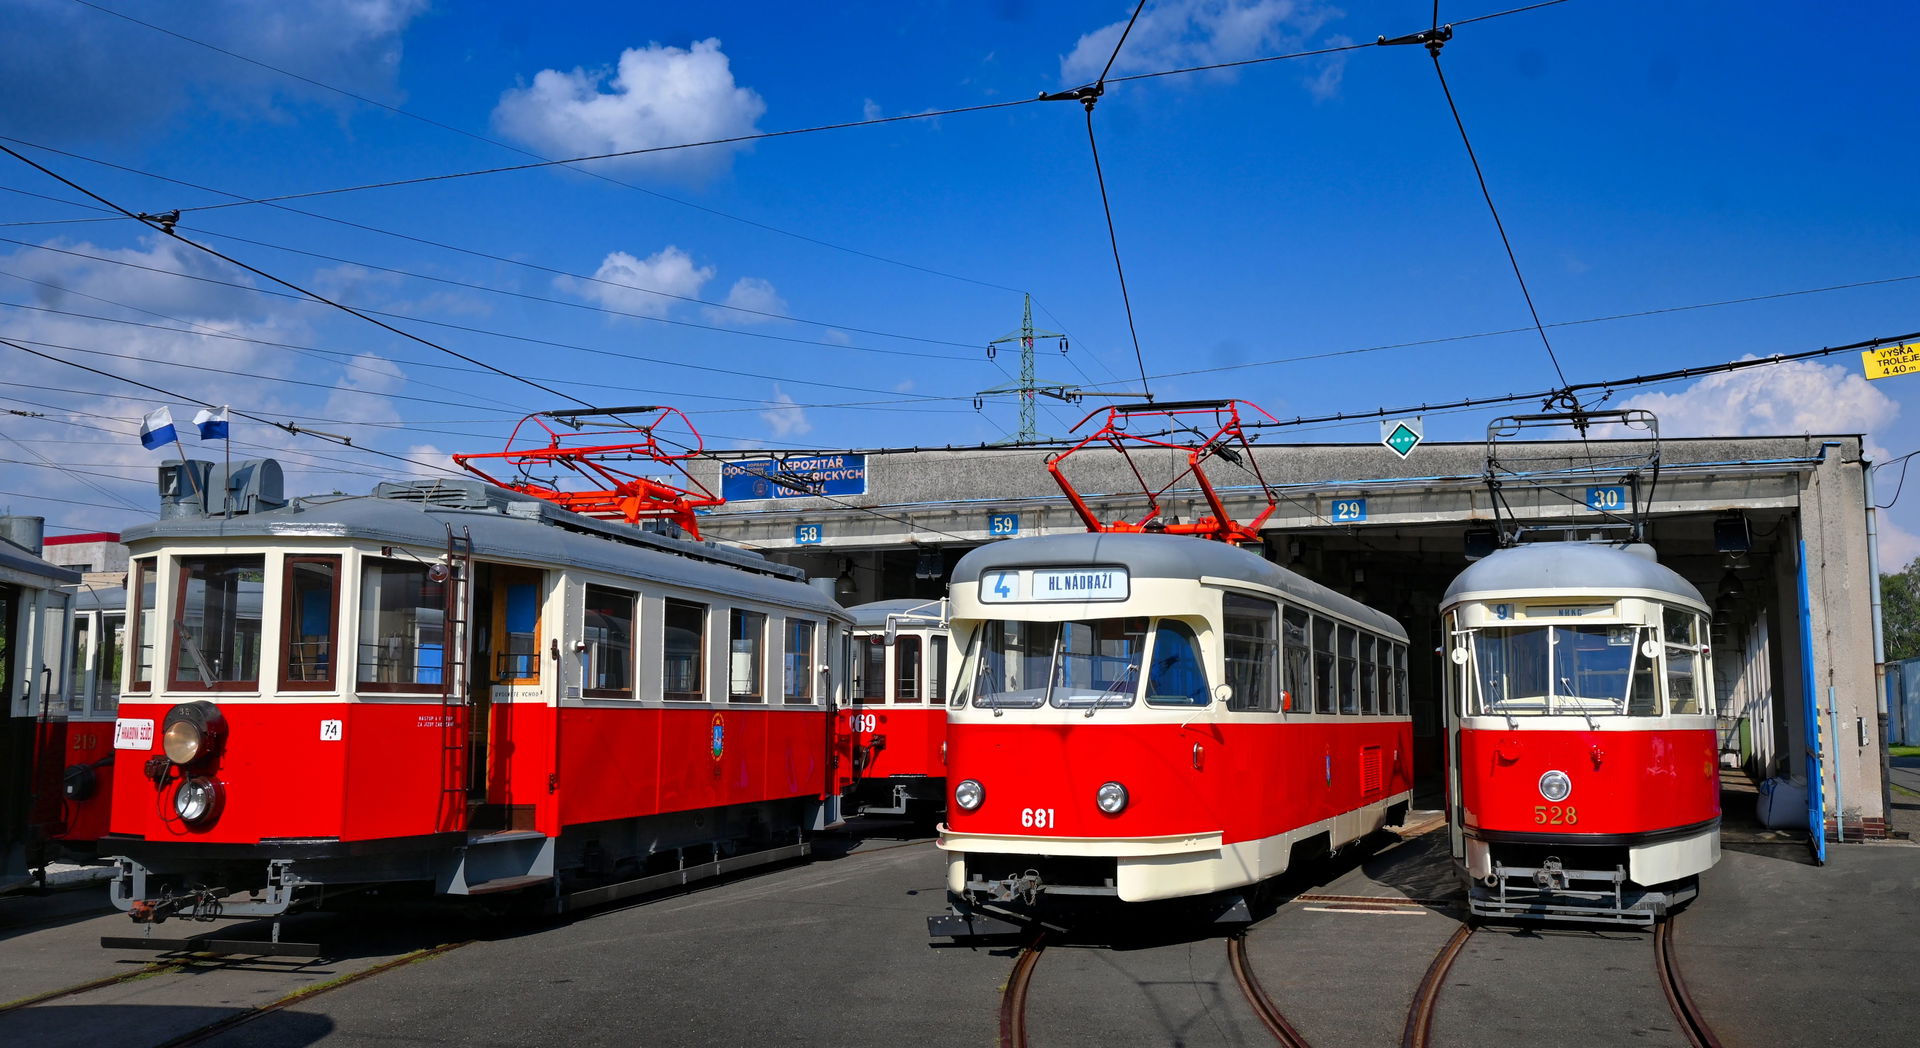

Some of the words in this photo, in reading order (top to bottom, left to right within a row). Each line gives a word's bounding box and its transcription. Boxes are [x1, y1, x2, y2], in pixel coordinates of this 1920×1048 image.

[1877, 354, 1920, 367] TROLEJE
[1595, 489, 1618, 508] 30
[1338, 502, 1360, 519] 29
[994, 517, 1013, 533] 59
[800, 526, 817, 542] 58
[994, 571, 1011, 598] 4
[1065, 573, 1113, 591] NÁDRAŽÍ
[1496, 604, 1508, 620] 9
[325, 724, 338, 736] 74
[1021, 807, 1055, 829] 681
[1534, 805, 1578, 825] 528
